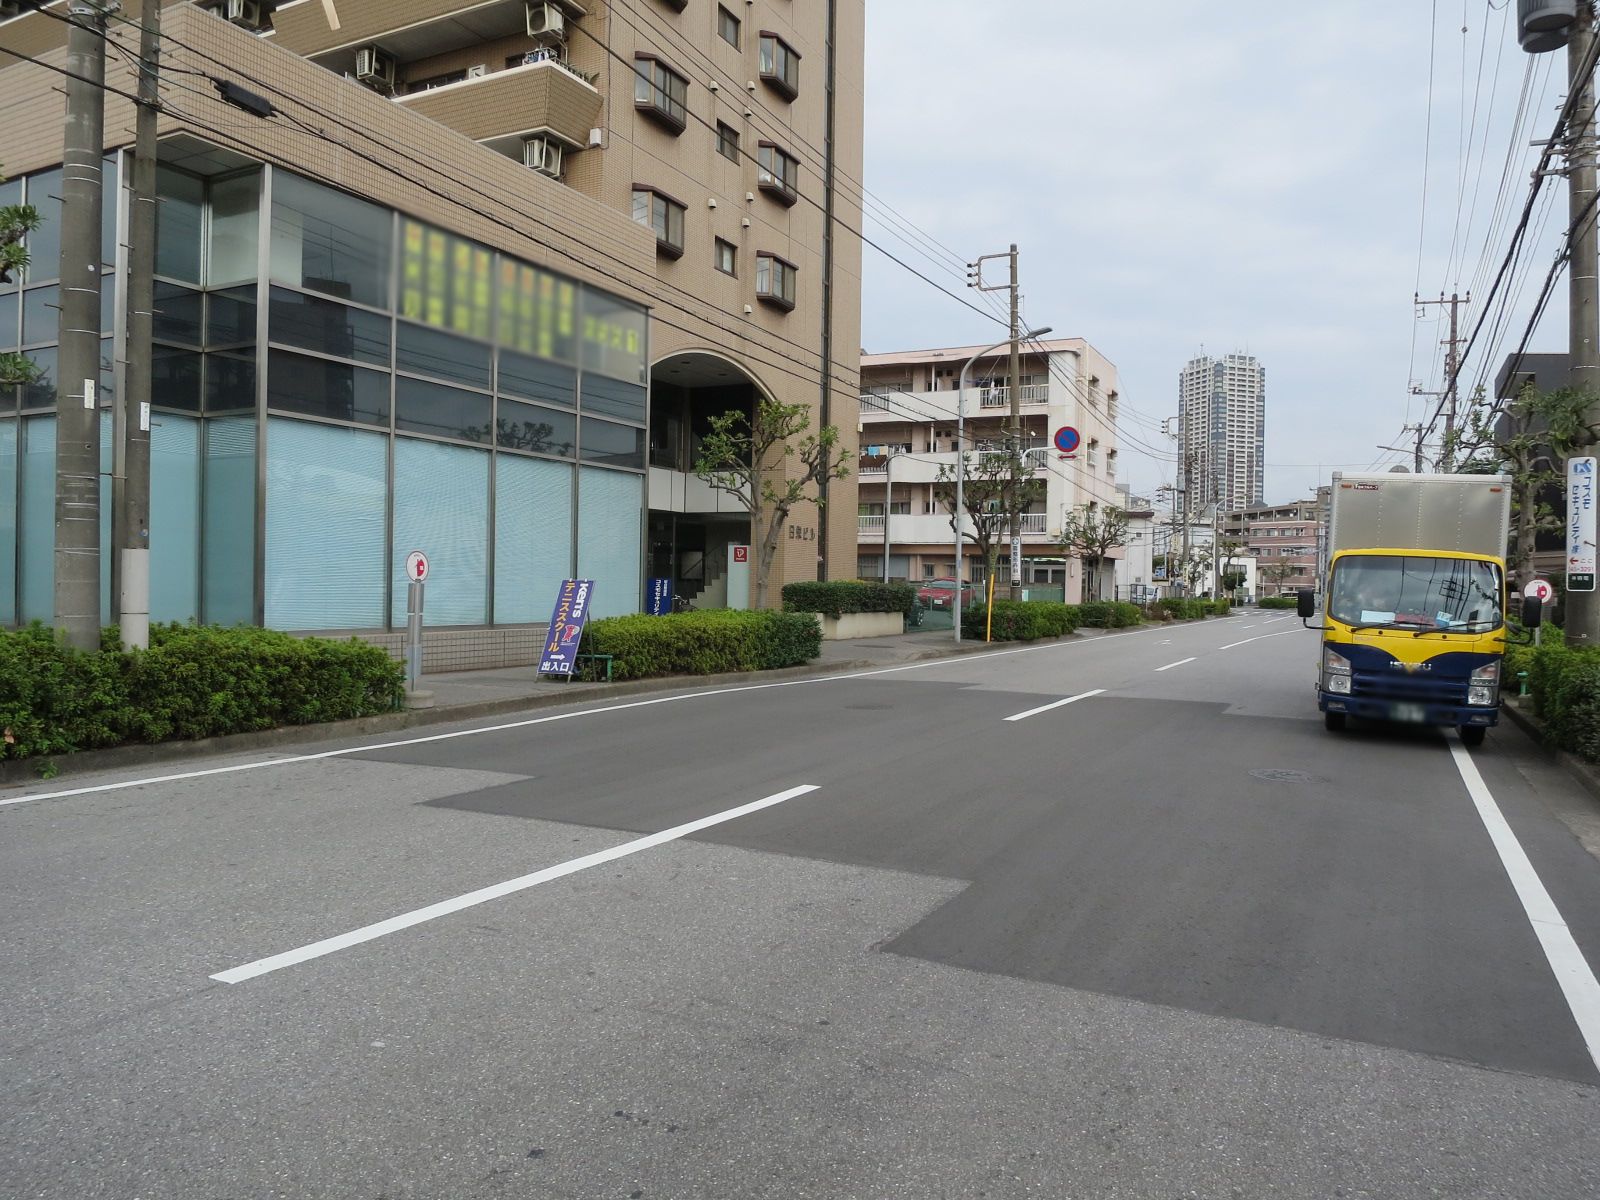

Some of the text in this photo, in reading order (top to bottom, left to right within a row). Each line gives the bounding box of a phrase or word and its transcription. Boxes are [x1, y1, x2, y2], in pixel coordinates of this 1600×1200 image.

[548, 582, 576, 652] テニススクール
[541, 661, 570, 672] 出入口
